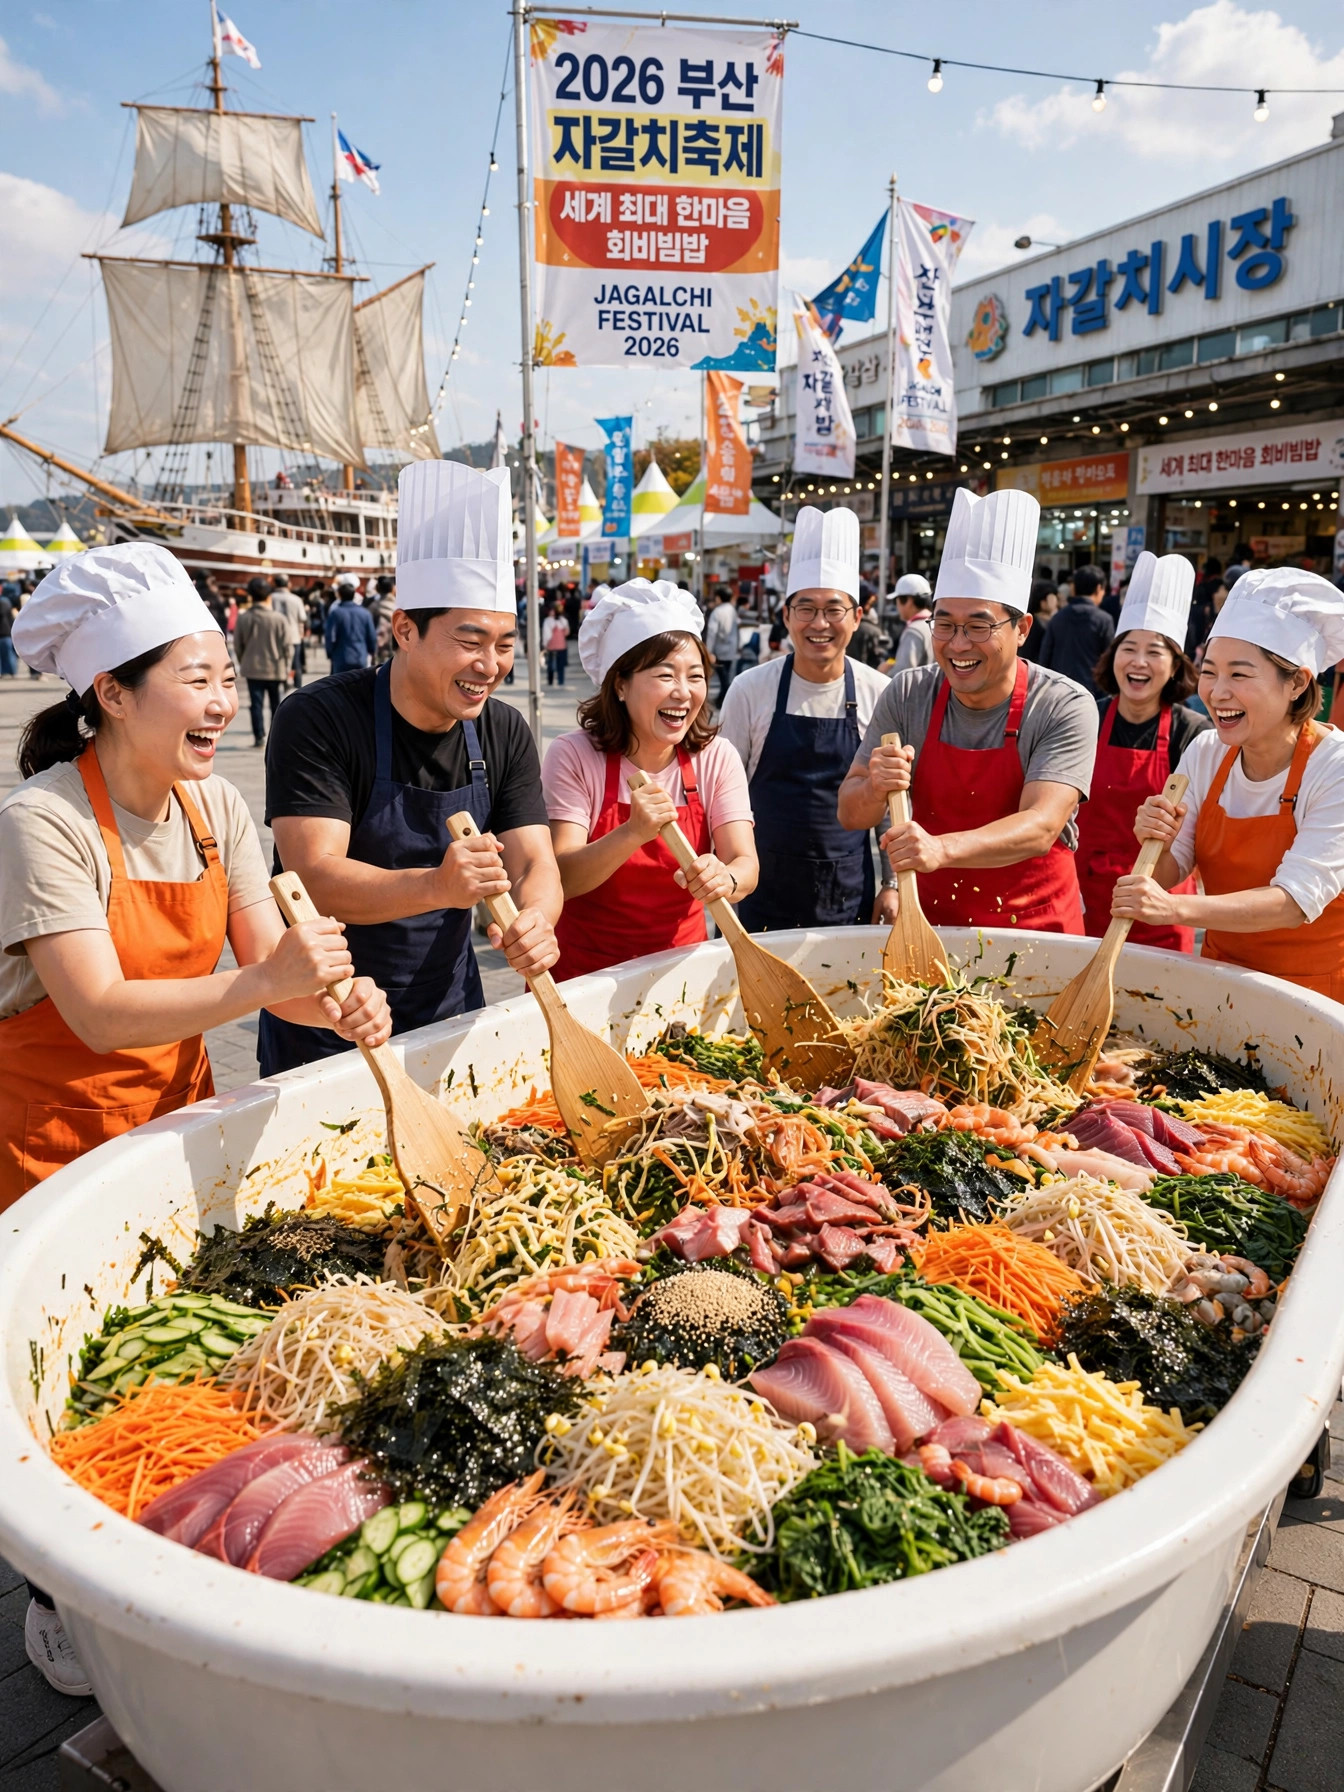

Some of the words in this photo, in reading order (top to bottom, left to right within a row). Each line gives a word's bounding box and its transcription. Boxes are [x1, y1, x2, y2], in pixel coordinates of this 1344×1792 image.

[554, 52, 665, 105] 2026
[677, 58, 759, 113] 부산
[552, 115, 764, 178] 자갈치축제
[560, 190, 612, 225] 세계
[618, 192, 669, 227] 최대
[675, 195, 751, 229] 한마음
[605, 229, 710, 264] 회비빔밥
[1022, 196, 1295, 342] 자갈치시장
[593, 284, 712, 308] JAGALCHI
[597, 310, 711, 334] FESTIVAL
[623, 336, 680, 358] 2026
[1159, 453, 1185, 478] 세계
[1187, 450, 1214, 475] 최대
[1215, 446, 1256, 472] 한마음
[1259, 437, 1322, 466] 회비빔밥
